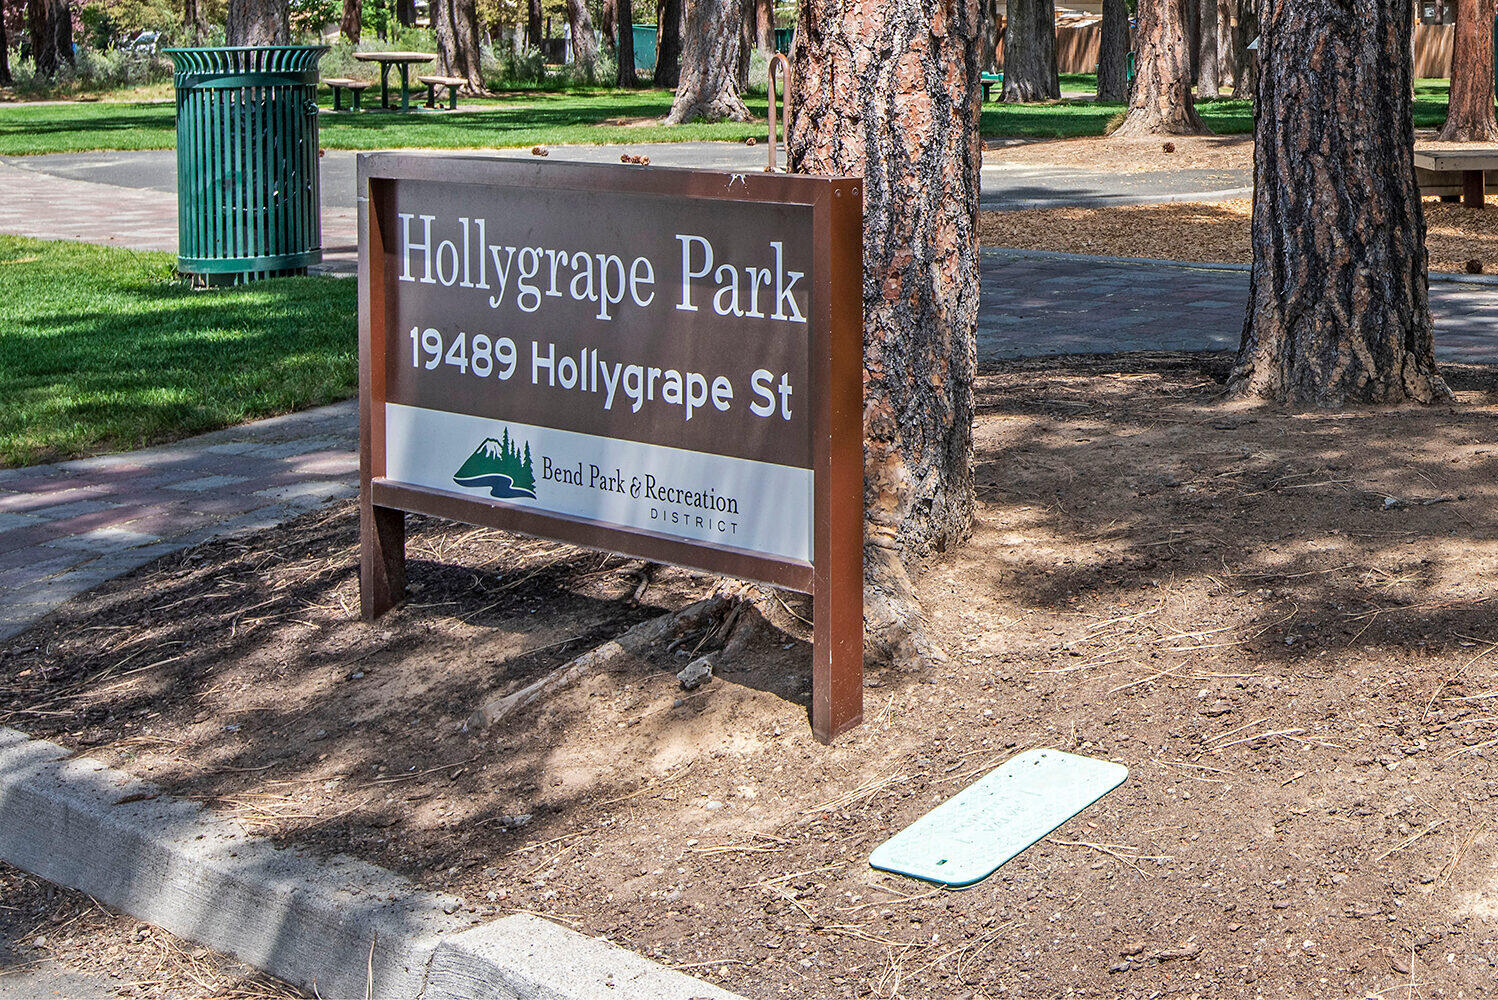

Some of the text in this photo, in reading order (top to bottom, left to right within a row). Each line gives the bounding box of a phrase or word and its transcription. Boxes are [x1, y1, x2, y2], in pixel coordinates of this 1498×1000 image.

[399, 213, 807, 323] Hollygrape Park
[410, 326, 793, 421] 19489 Hollygrape St
[542, 456, 739, 514] Bend Park & Recreation
[650, 508, 739, 534] DISTRICT
